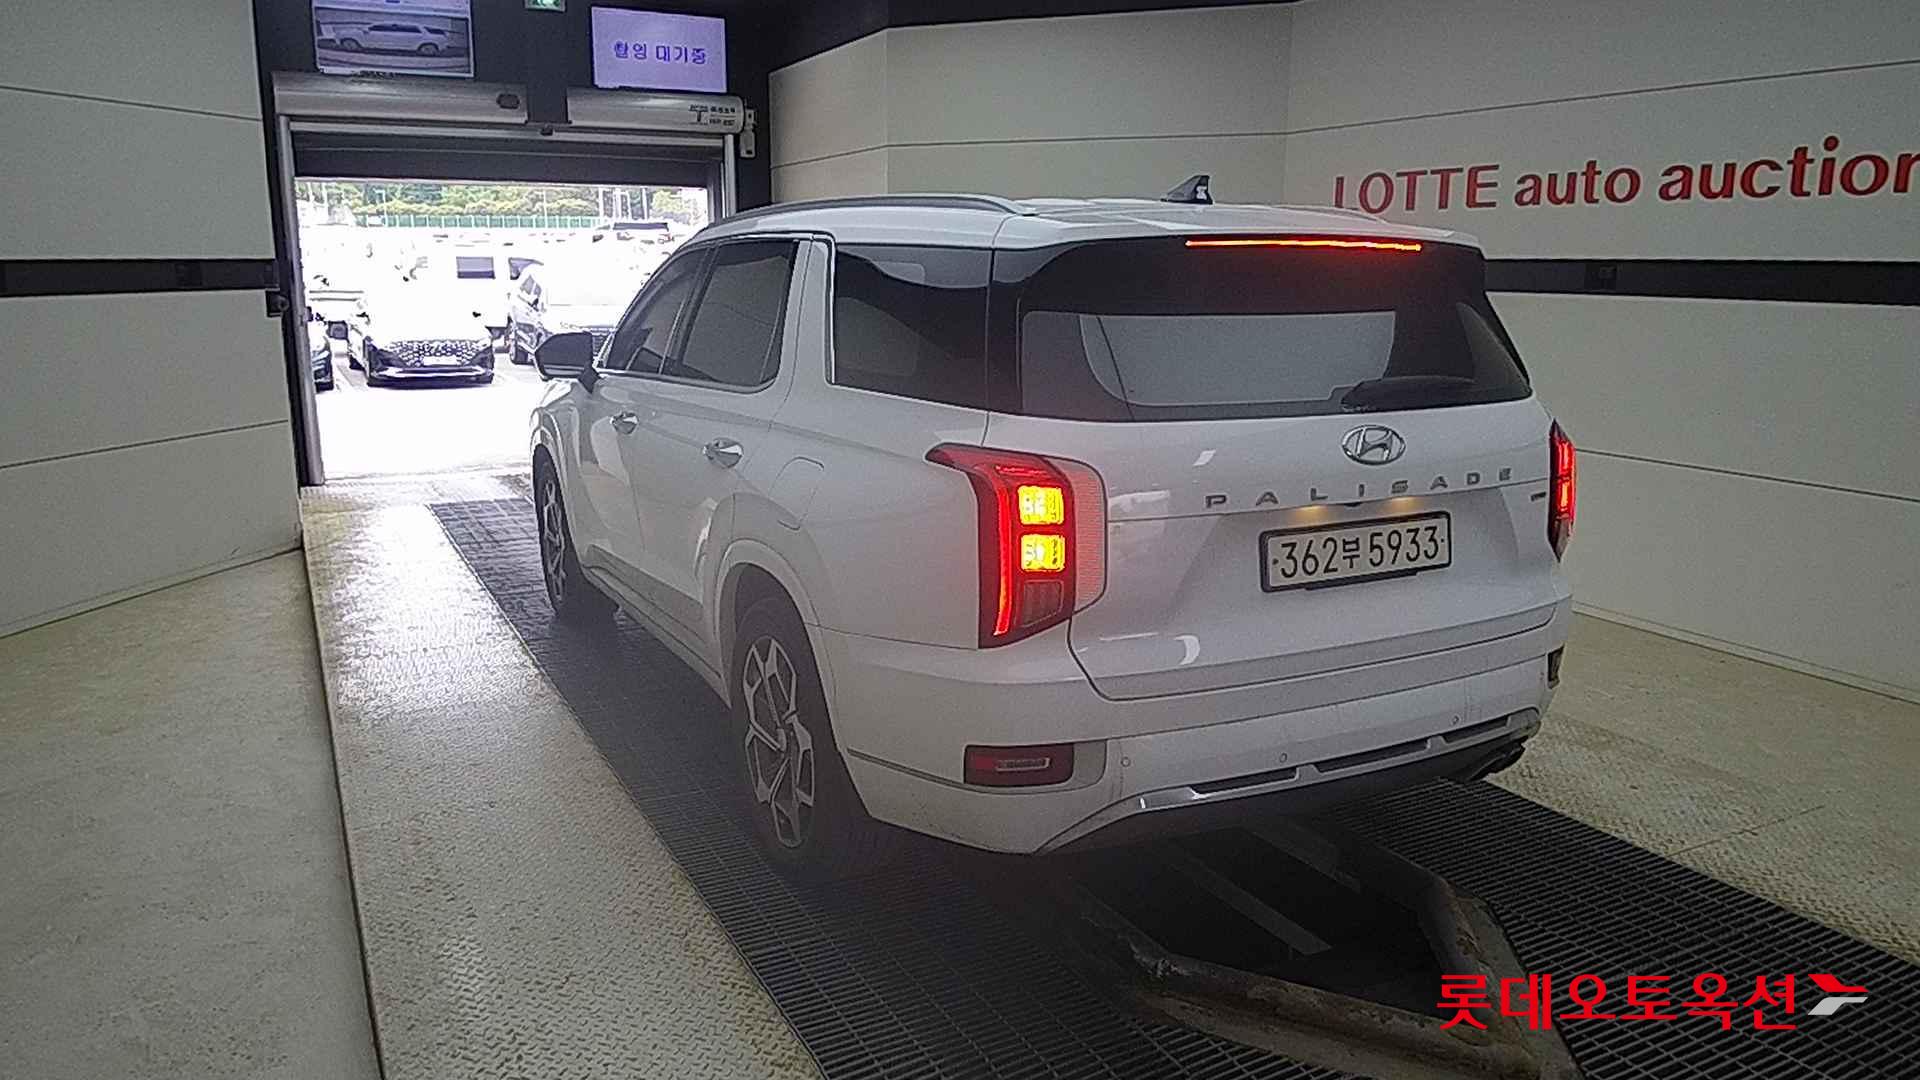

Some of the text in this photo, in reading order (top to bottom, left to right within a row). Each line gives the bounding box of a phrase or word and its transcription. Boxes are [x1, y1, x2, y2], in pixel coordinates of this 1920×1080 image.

[1334, 164, 1499, 215] LOTTE
[1514, 160, 1640, 207] auto
[1205, 467, 1512, 509] PALISADE
